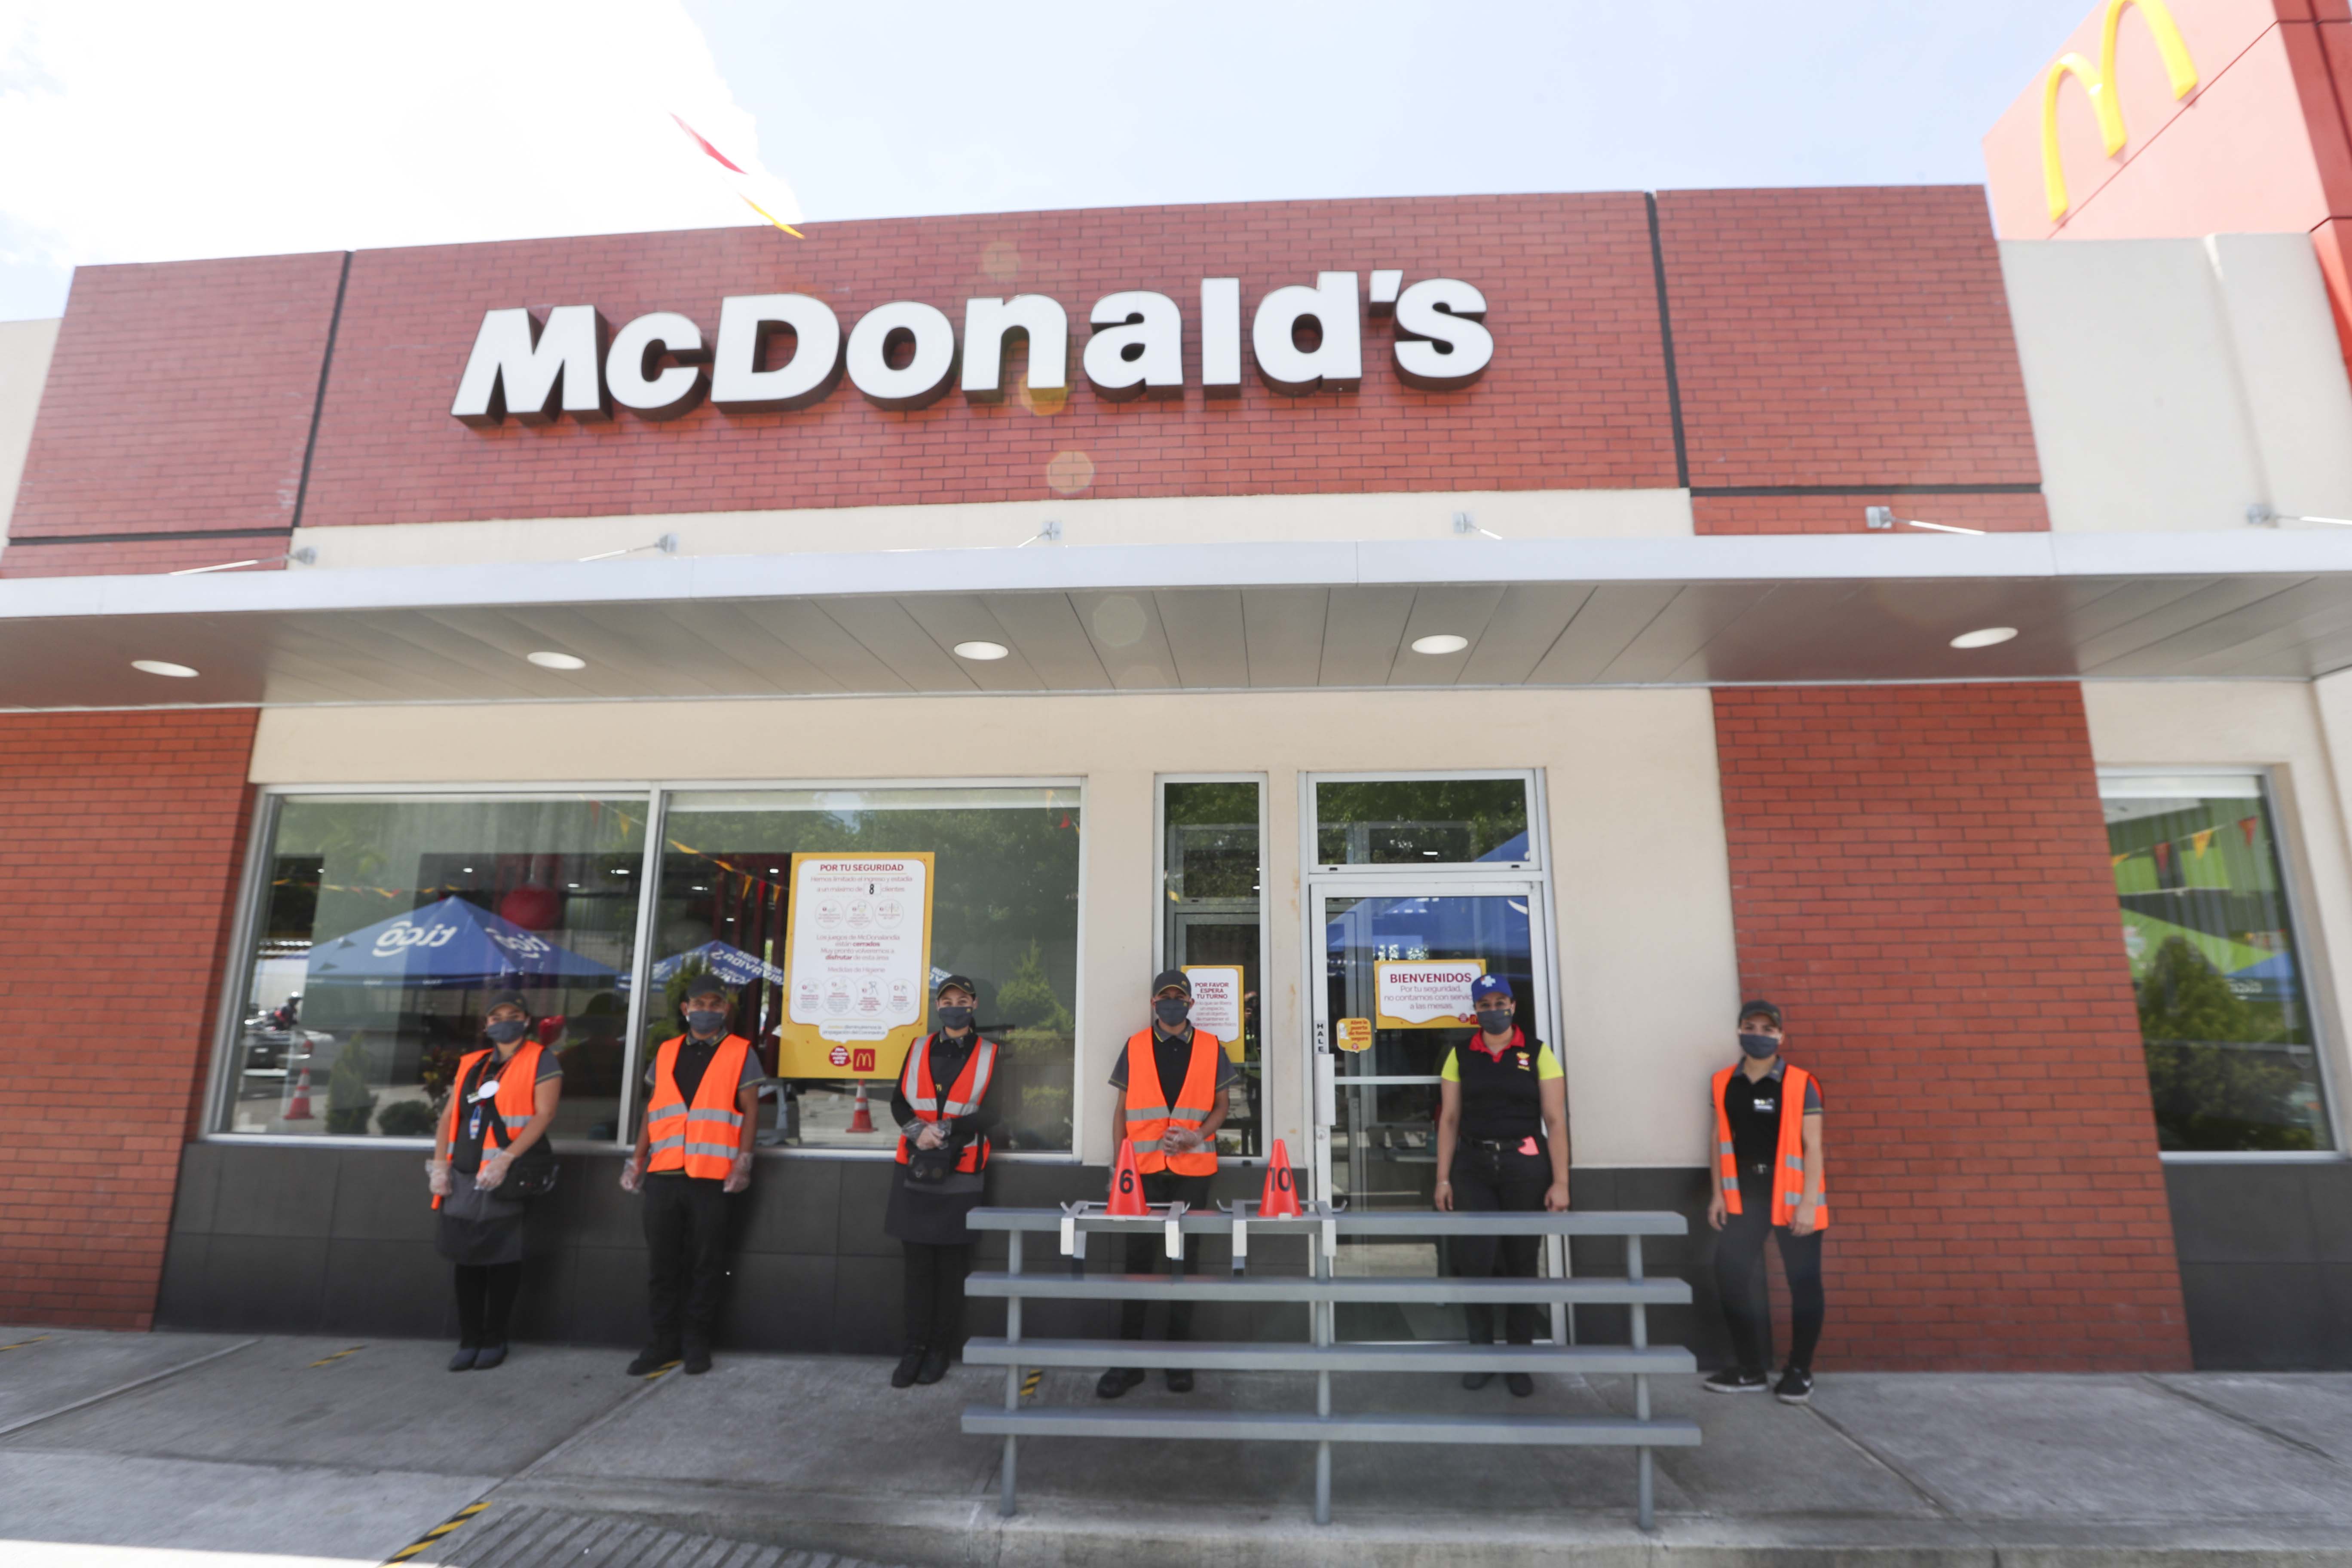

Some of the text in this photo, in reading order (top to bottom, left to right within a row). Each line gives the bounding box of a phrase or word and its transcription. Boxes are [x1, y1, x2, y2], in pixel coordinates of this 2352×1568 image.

[450, 269, 1495, 423] McDonald's
[869, 884, 874, 894] 8
[1390, 973, 1472, 983] BIENVENIDOS
[1119, 1169, 1133, 1194] 6
[1269, 1167, 1290, 1192] 10
